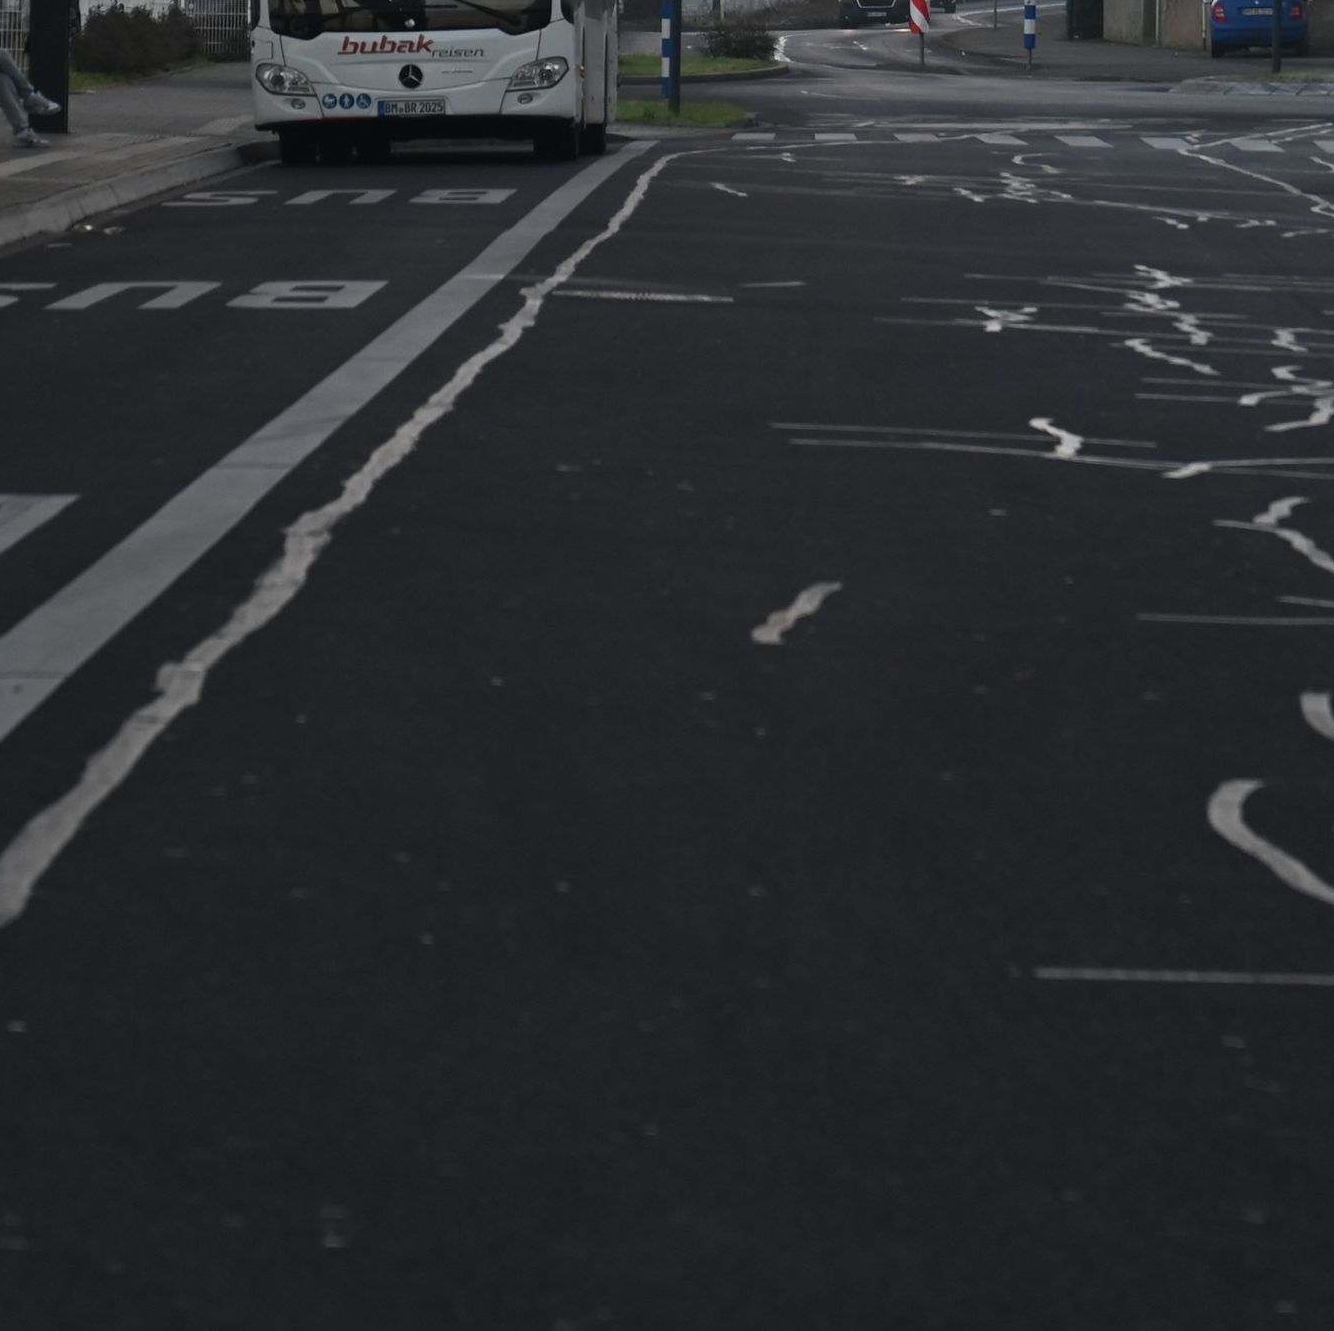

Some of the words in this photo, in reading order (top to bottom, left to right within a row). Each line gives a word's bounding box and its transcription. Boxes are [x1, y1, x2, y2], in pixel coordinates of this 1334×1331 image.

[337, 34, 434, 56] bubak
[431, 46, 484, 58] reisen
[385, 101, 398, 113] BM
[419, 100, 443, 113] 2025
[161, 188, 517, 207] BUS
